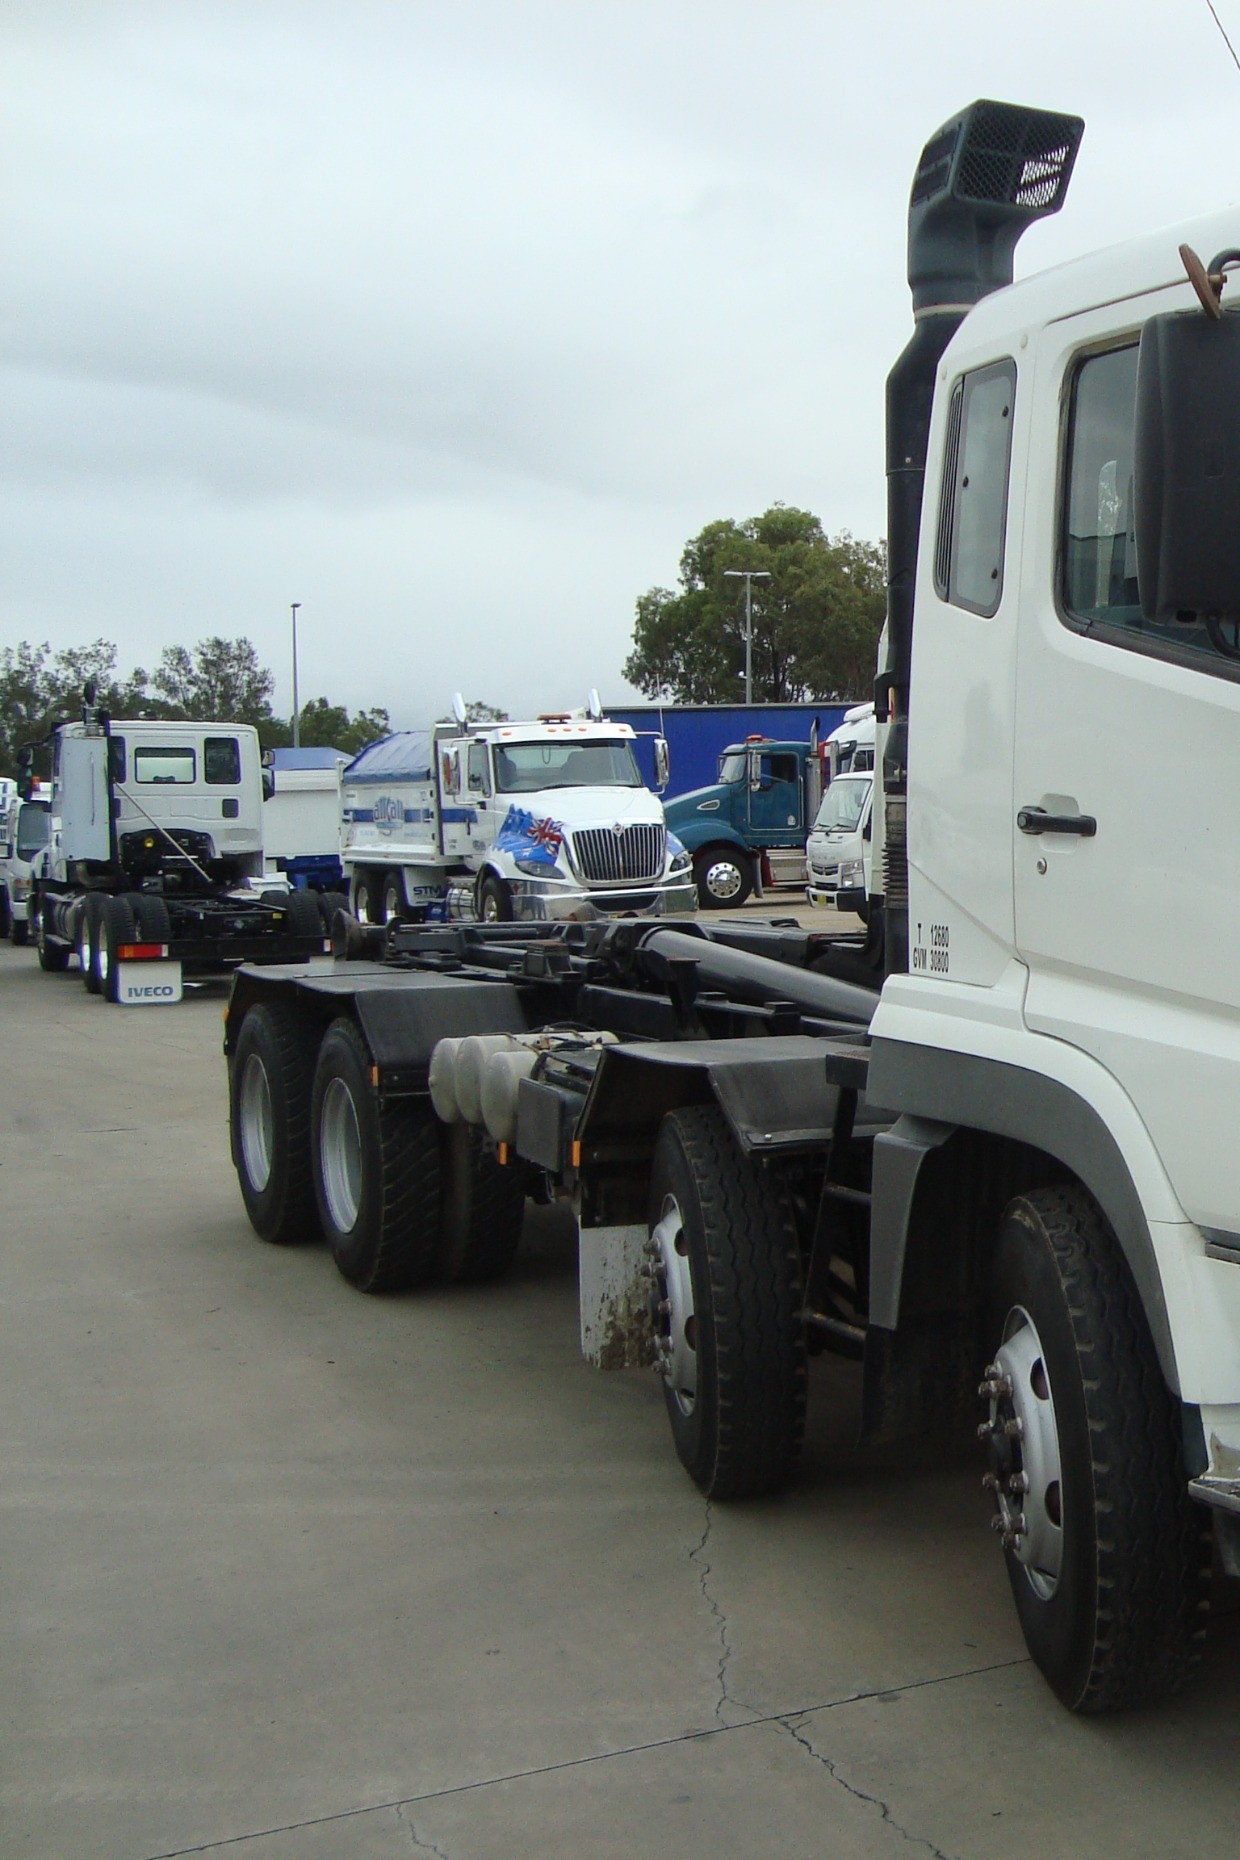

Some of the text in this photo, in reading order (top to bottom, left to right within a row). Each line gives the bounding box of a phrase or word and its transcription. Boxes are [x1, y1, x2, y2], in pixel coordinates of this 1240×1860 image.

[413, 886, 441, 896] STM
[913, 947, 927, 969] GVM
[128, 986, 173, 997] IVECO
